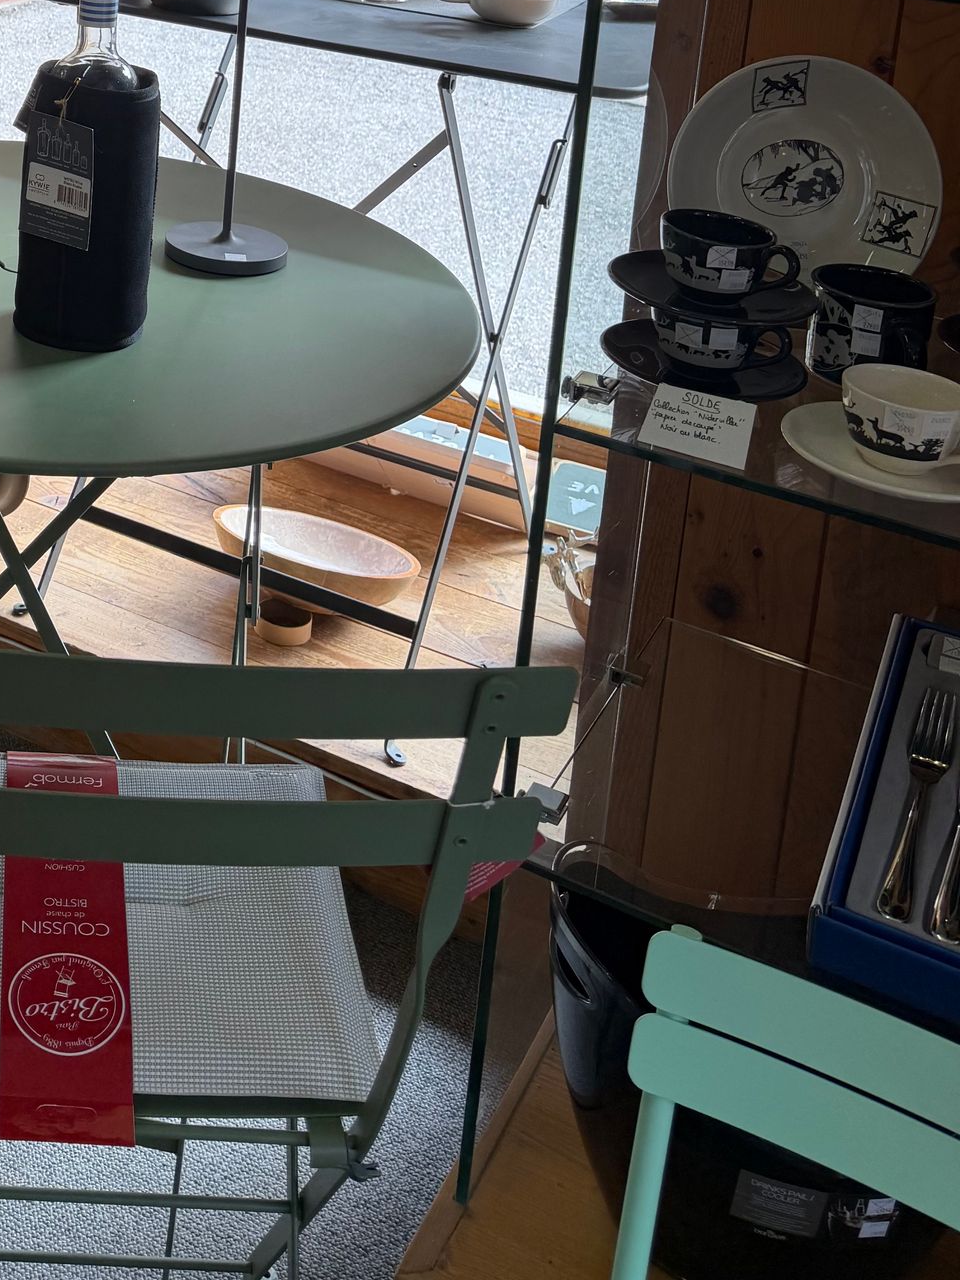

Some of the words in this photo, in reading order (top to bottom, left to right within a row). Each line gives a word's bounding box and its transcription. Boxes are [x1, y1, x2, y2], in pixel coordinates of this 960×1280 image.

[653, 399, 690, 416] Collection
[681, 391, 722, 410] SOLDE
[30, 773, 103, 789] Fermob
[44, 863, 86, 872] CUSHION
[43, 897, 88, 908] BISTRO
[46, 910, 72, 918] chaise
[74, 910, 86, 918] de
[21, 920, 110, 937] COUSSIN
[51, 955, 65, 966] par
[24, 995, 114, 1022] Bistro
[55, 1021, 80, 1031] Paris
[64, 1036, 95, 1049] Depuis
[751, 1178, 786, 1195] DRINKS
[761, 1189, 801, 1205] COOLER
